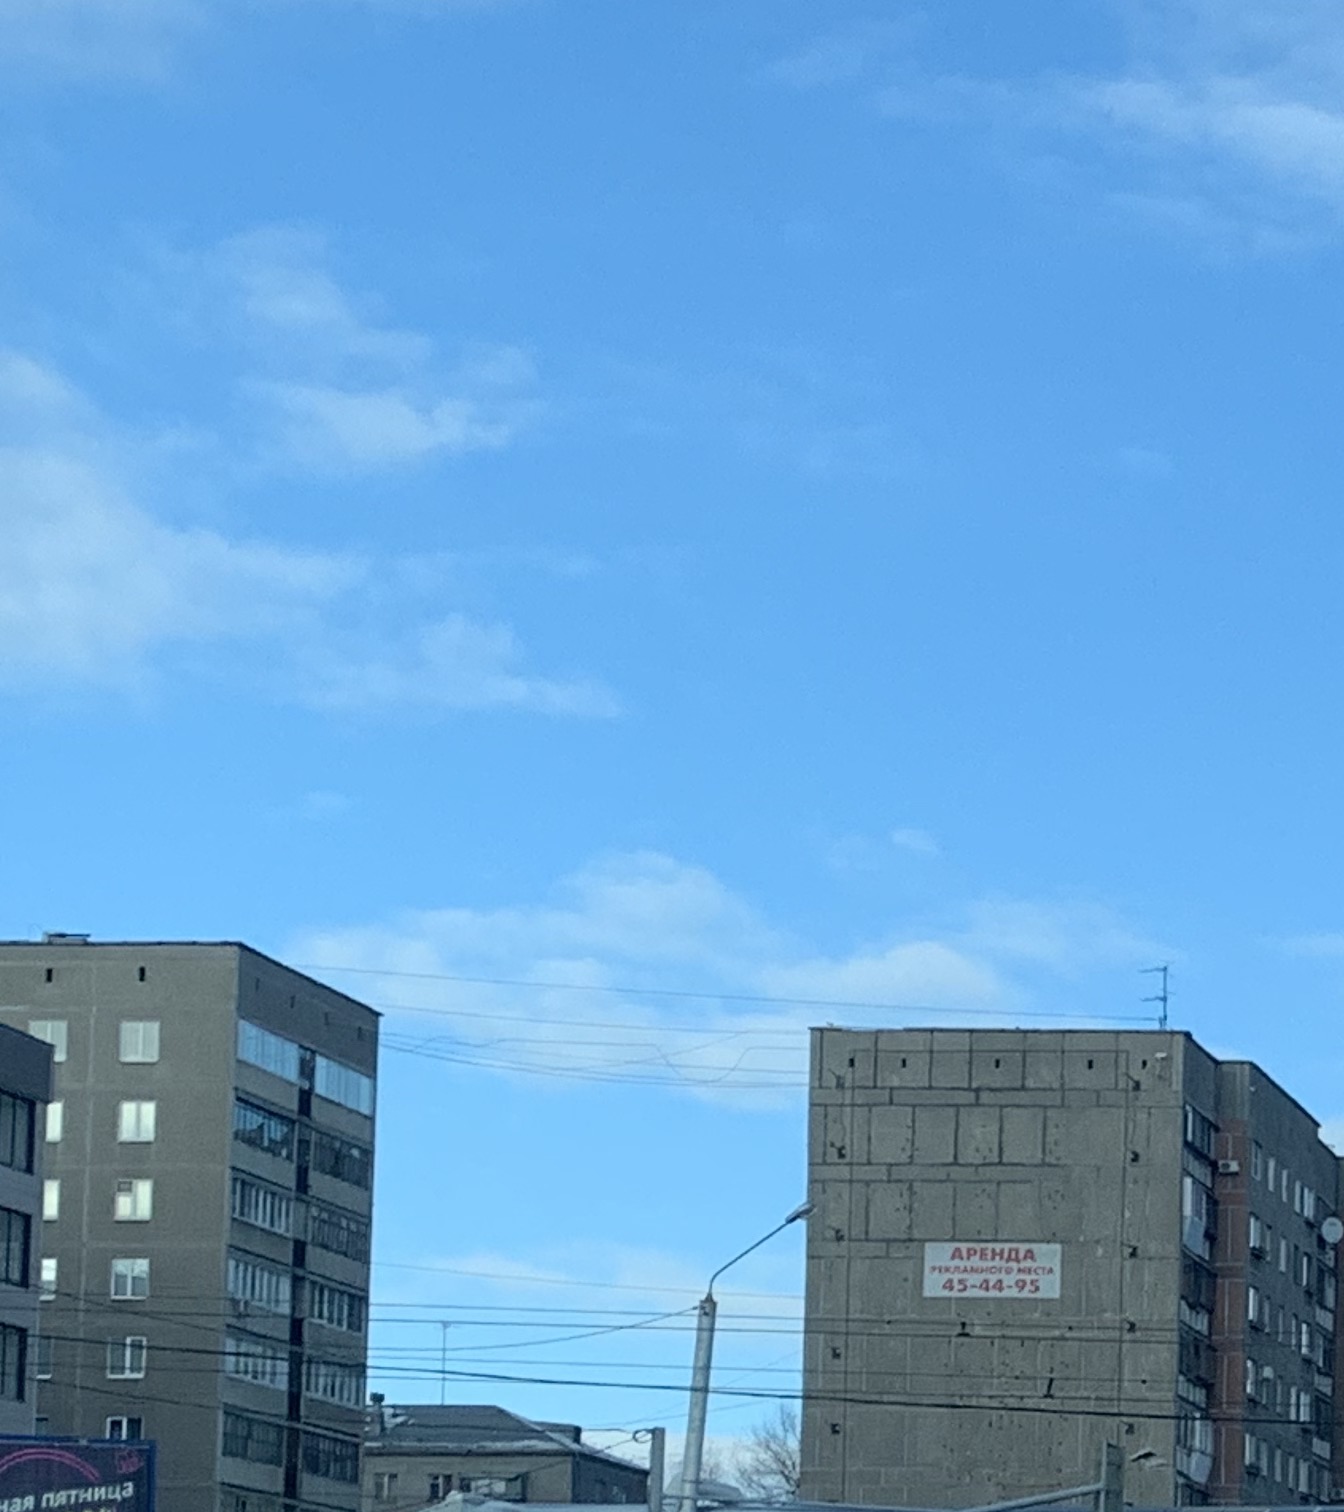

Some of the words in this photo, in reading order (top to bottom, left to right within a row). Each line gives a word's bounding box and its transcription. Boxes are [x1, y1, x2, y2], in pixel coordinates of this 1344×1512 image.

[950, 1247, 1037, 1264] АРЕНДА
[929, 1265, 1014, 1275] РЕКЛАМНОГО
[1017, 1265, 1054, 1275] МЕСТА
[942, 1278, 1041, 1294] 45-44-95
[41, 1481, 135, 1509] пятница
